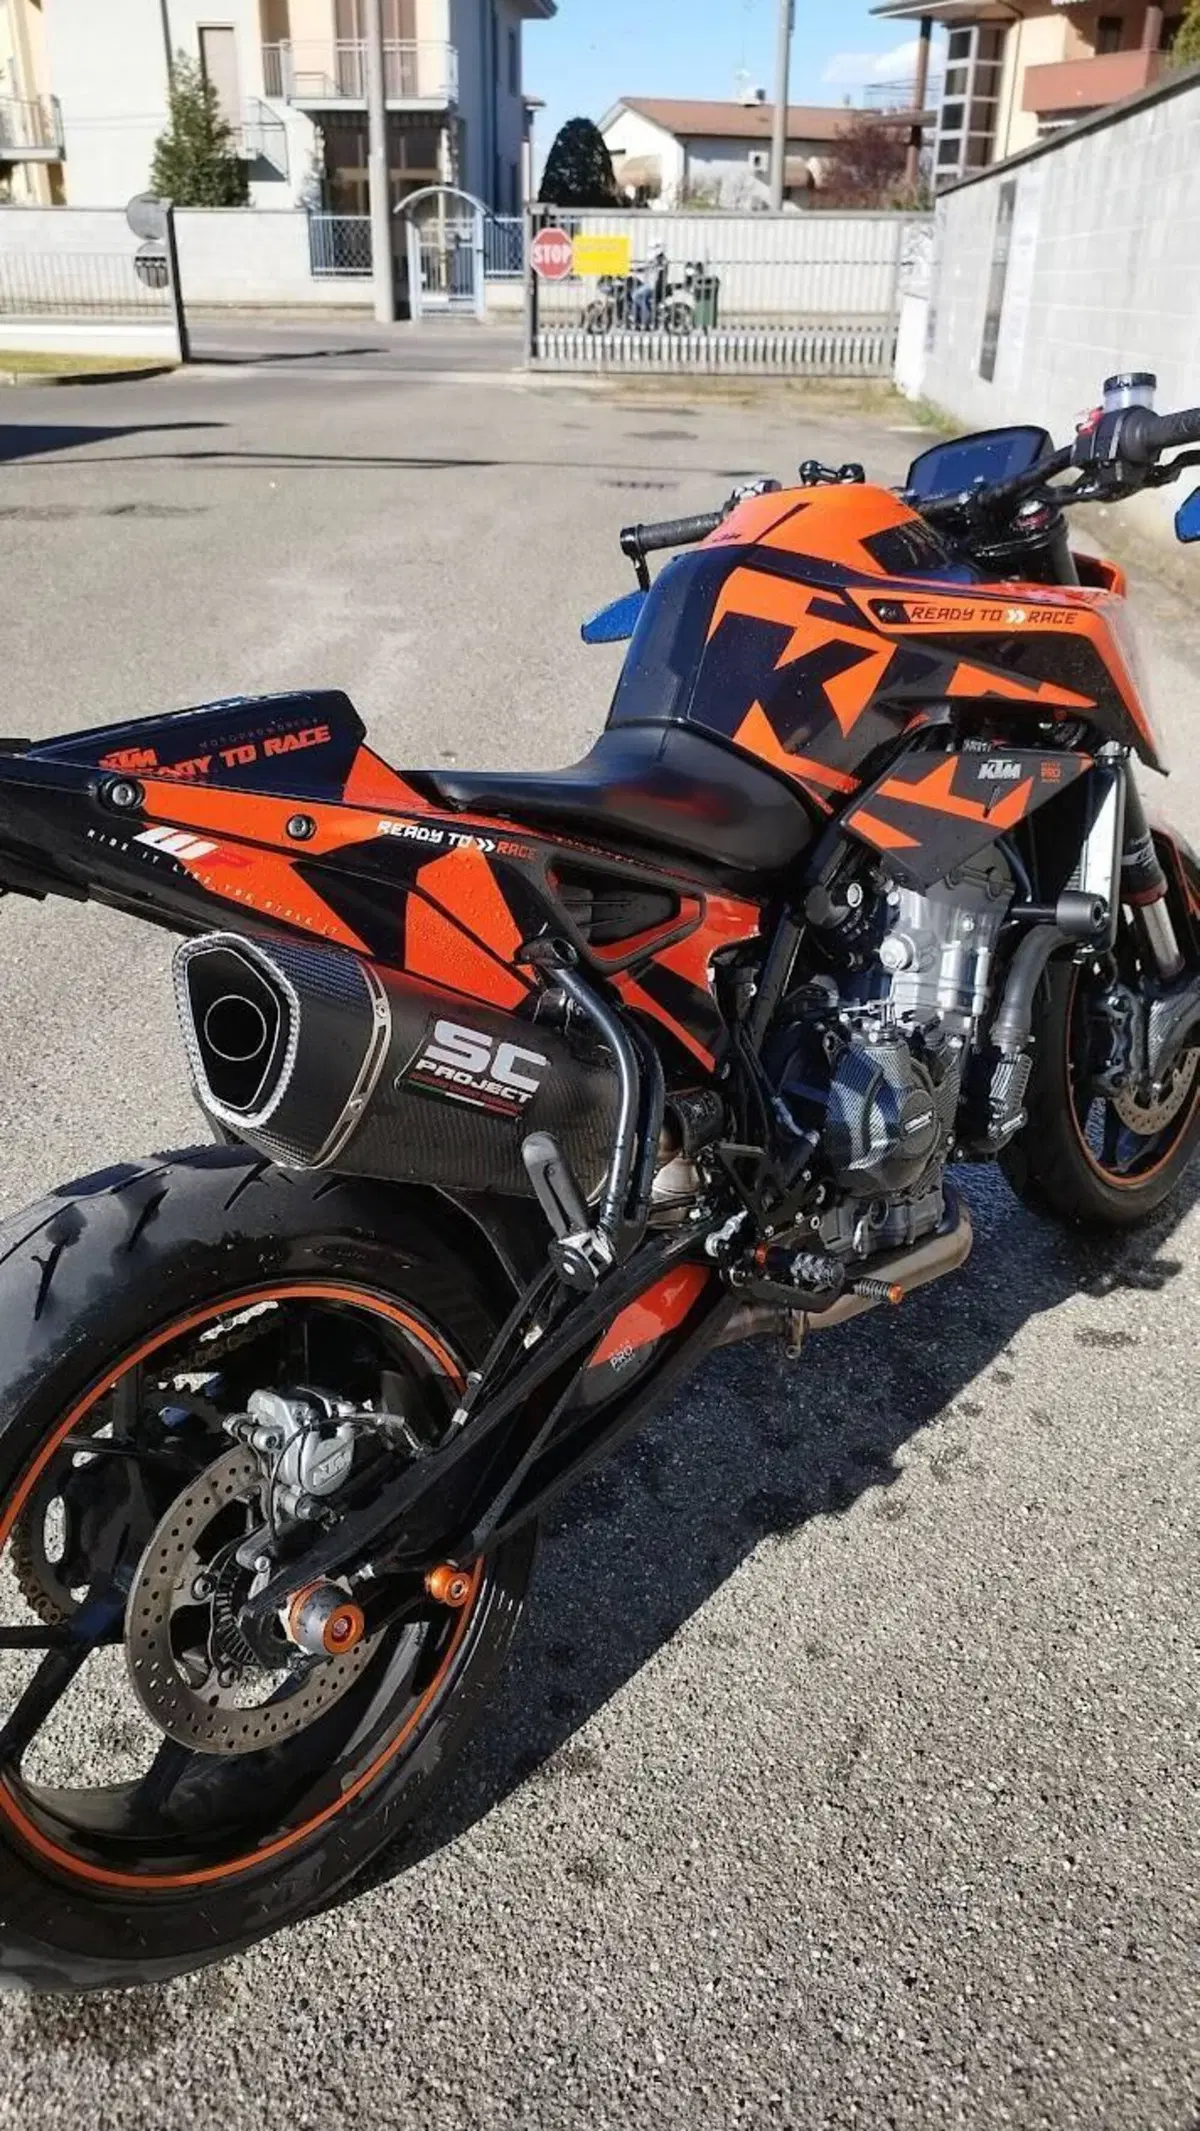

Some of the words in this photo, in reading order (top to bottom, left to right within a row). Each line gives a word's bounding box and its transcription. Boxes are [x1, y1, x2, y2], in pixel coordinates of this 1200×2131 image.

[534, 244, 572, 265] STOP
[911, 607, 974, 621] READY
[980, 609, 1001, 621] TO
[1027, 611, 1078, 624] RACE
[99, 748, 157, 769] KTM
[219, 744, 257, 768] TO
[264, 726, 332, 757] RACE
[978, 759, 1022, 779] KTM
[87, 828, 129, 851] RIDE
[142, 851, 159, 864] IT
[172, 863, 213, 885] LIKE
[377, 821, 444, 844] READY
[447, 832, 473, 848] TO
[497, 840, 537, 860] RACE
[424, 1019, 549, 1093] SC
[415, 1058, 533, 1104] PROJECT
[610, 1345, 633, 1372] PRO
